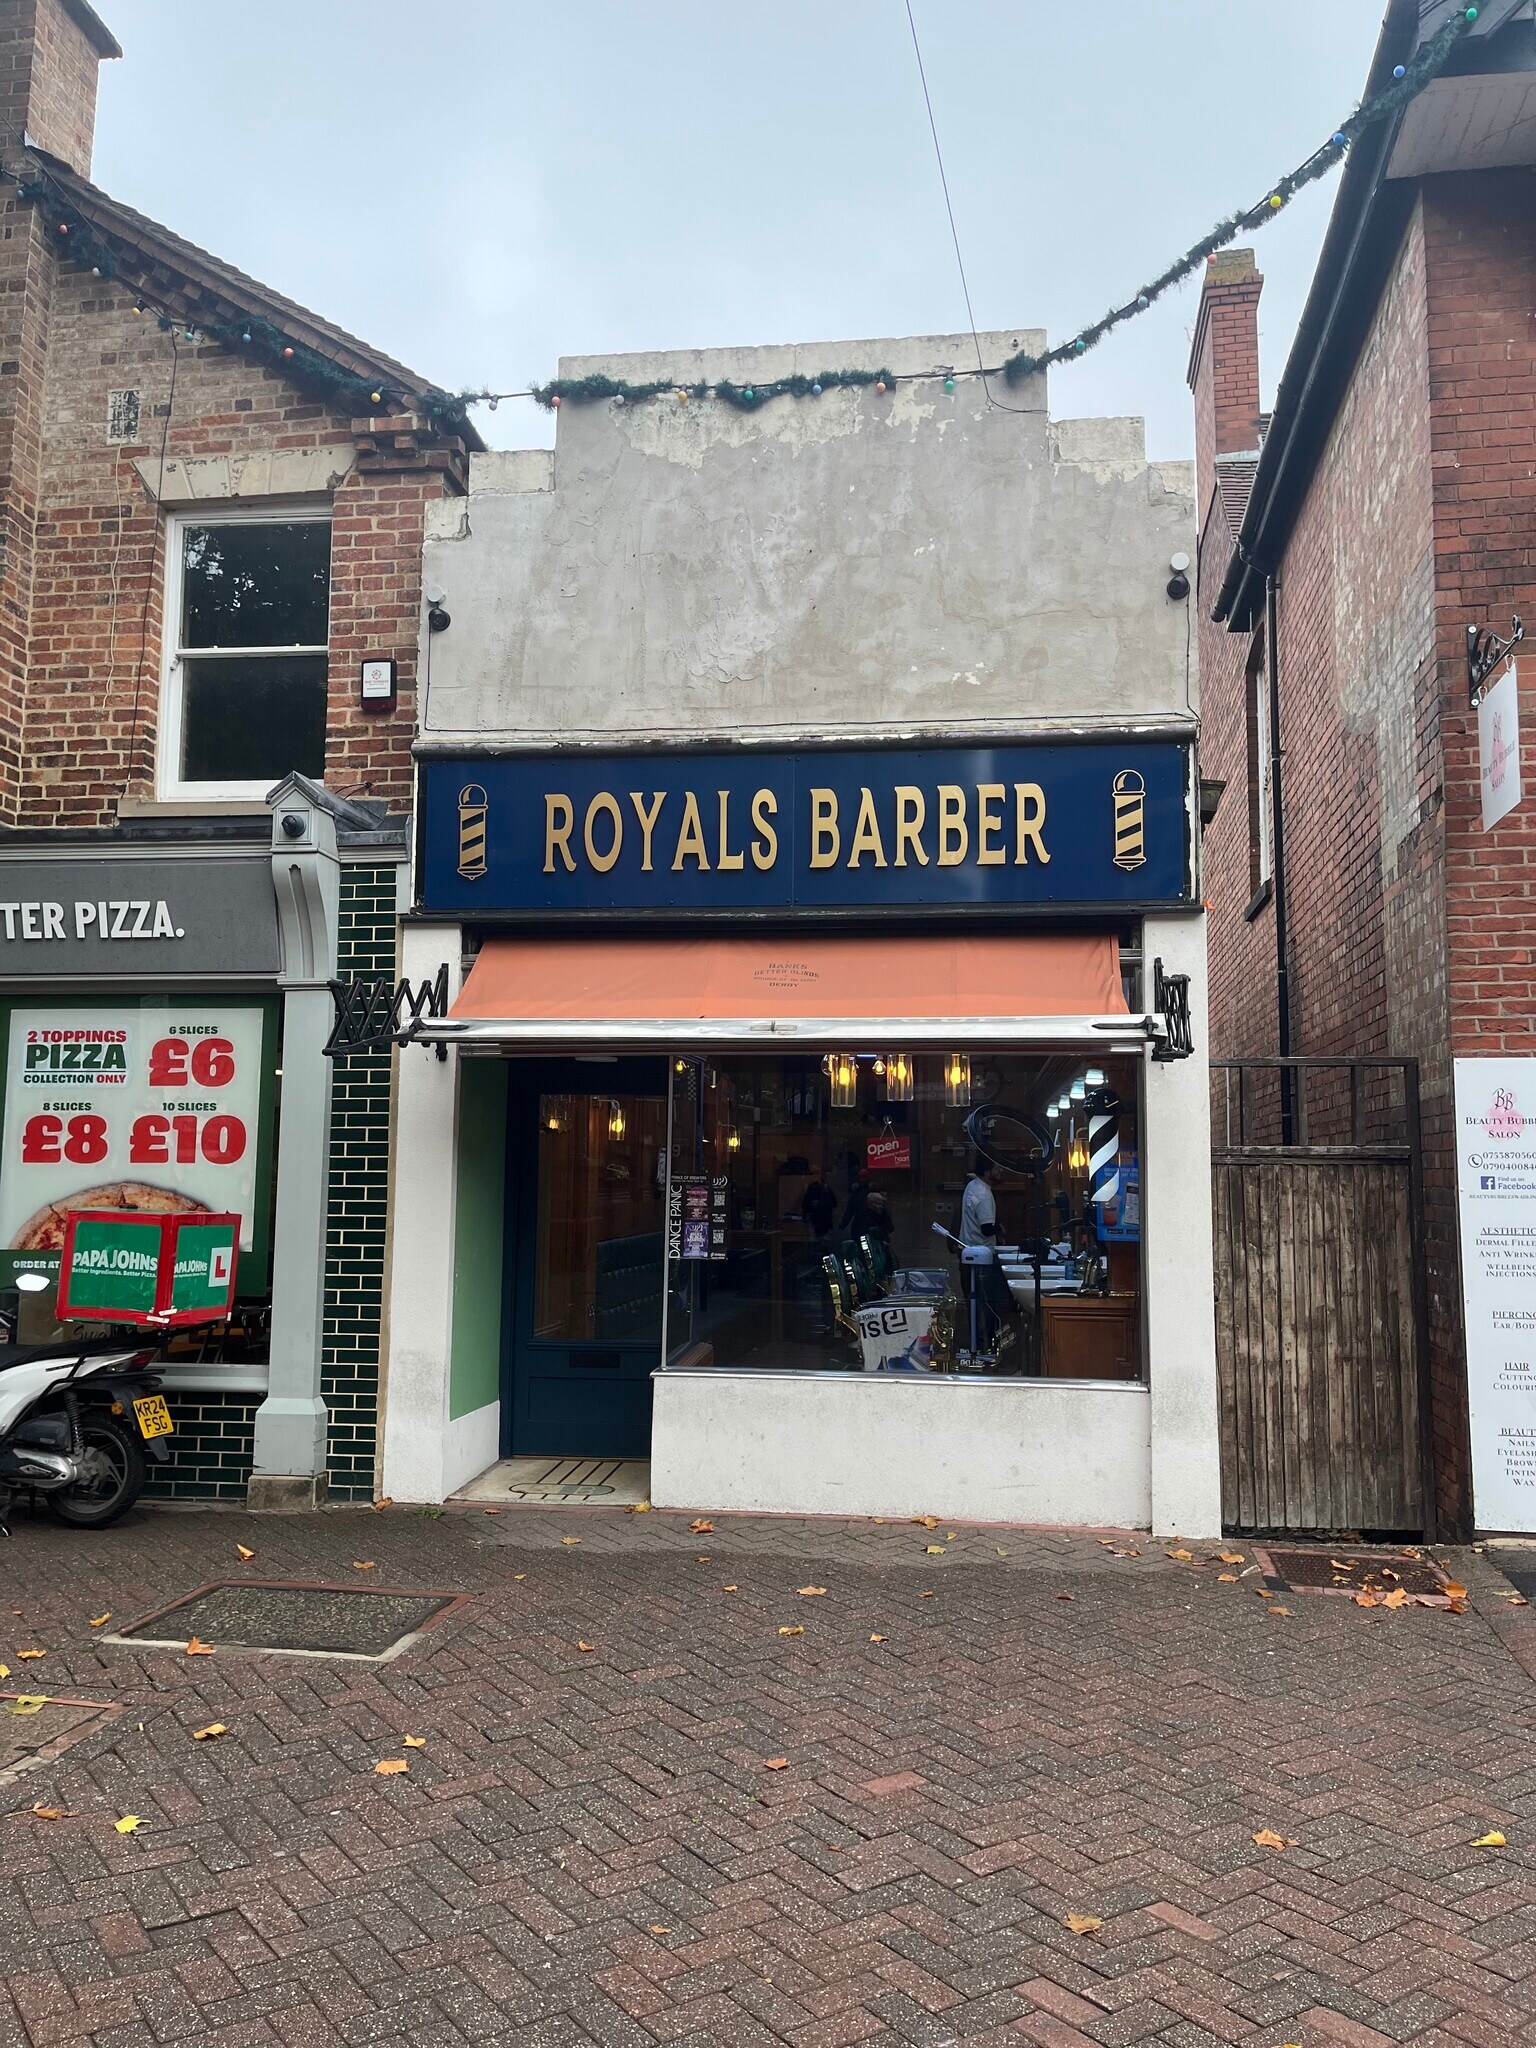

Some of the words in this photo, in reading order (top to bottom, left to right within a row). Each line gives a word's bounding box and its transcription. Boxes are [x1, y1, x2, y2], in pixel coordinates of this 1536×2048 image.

[543, 788, 779, 873] ROYALS
[810, 783, 1051, 869] BARBER
[0, 902, 67, 939] TER
[74, 900, 186, 939] PIZZA.
[169, 1026, 177, 1035] 6
[178, 1026, 218, 1035] SLICES
[27, 1030, 38, 1043] 2
[41, 1030, 127, 1043] TOPPINGS
[26, 1043, 127, 1069] PIZZA
[148, 1037, 235, 1087] £6
[23, 1074, 94, 1084] COLLECTION
[96, 1074, 126, 1084] ONLY
[43, 1102, 50, 1112] 8
[52, 1102, 92, 1112] SLICES
[162, 1102, 174, 1112] 10
[177, 1102, 217, 1112] SLICES
[1465, 1116, 1504, 1125] BEAUTY
[1507, 1116, 1536, 1125] BUBB
[1488, 1129, 1521, 1139] SALON
[22, 1114, 109, 1165] £8
[130, 1114, 247, 1165] £10
[867, 1140, 899, 1156] Open
[1482, 1162, 1536, 1170] 079040084
[670, 1185, 683, 1217] PANIC
[669, 1219, 682, 1259] DANCE
[1475, 1238, 1510, 1246] DERMAL
[1479, 1250, 1500, 1258] ANTI
[1503, 1250, 1536, 1258] WRINK
[13, 1261, 46, 1269] ORDER
[48, 1261, 60, 1269] AT
[72, 1250, 109, 1268] PAPA
[109, 1250, 158, 1271] JOHNS
[214, 1255, 227, 1279] L
[1493, 1321, 1536, 1330] EAR/BOD
[1504, 1362, 1530, 1371] HAIR
[1493, 1382, 1536, 1391] COLOURI
[135, 1399, 166, 1417] KR24
[144, 1415, 168, 1433] FSG
[1509, 1439, 1535, 1447] NAILS
[1506, 1458, 1536, 1466] BROW
[1513, 1478, 1535, 1487] WAX
